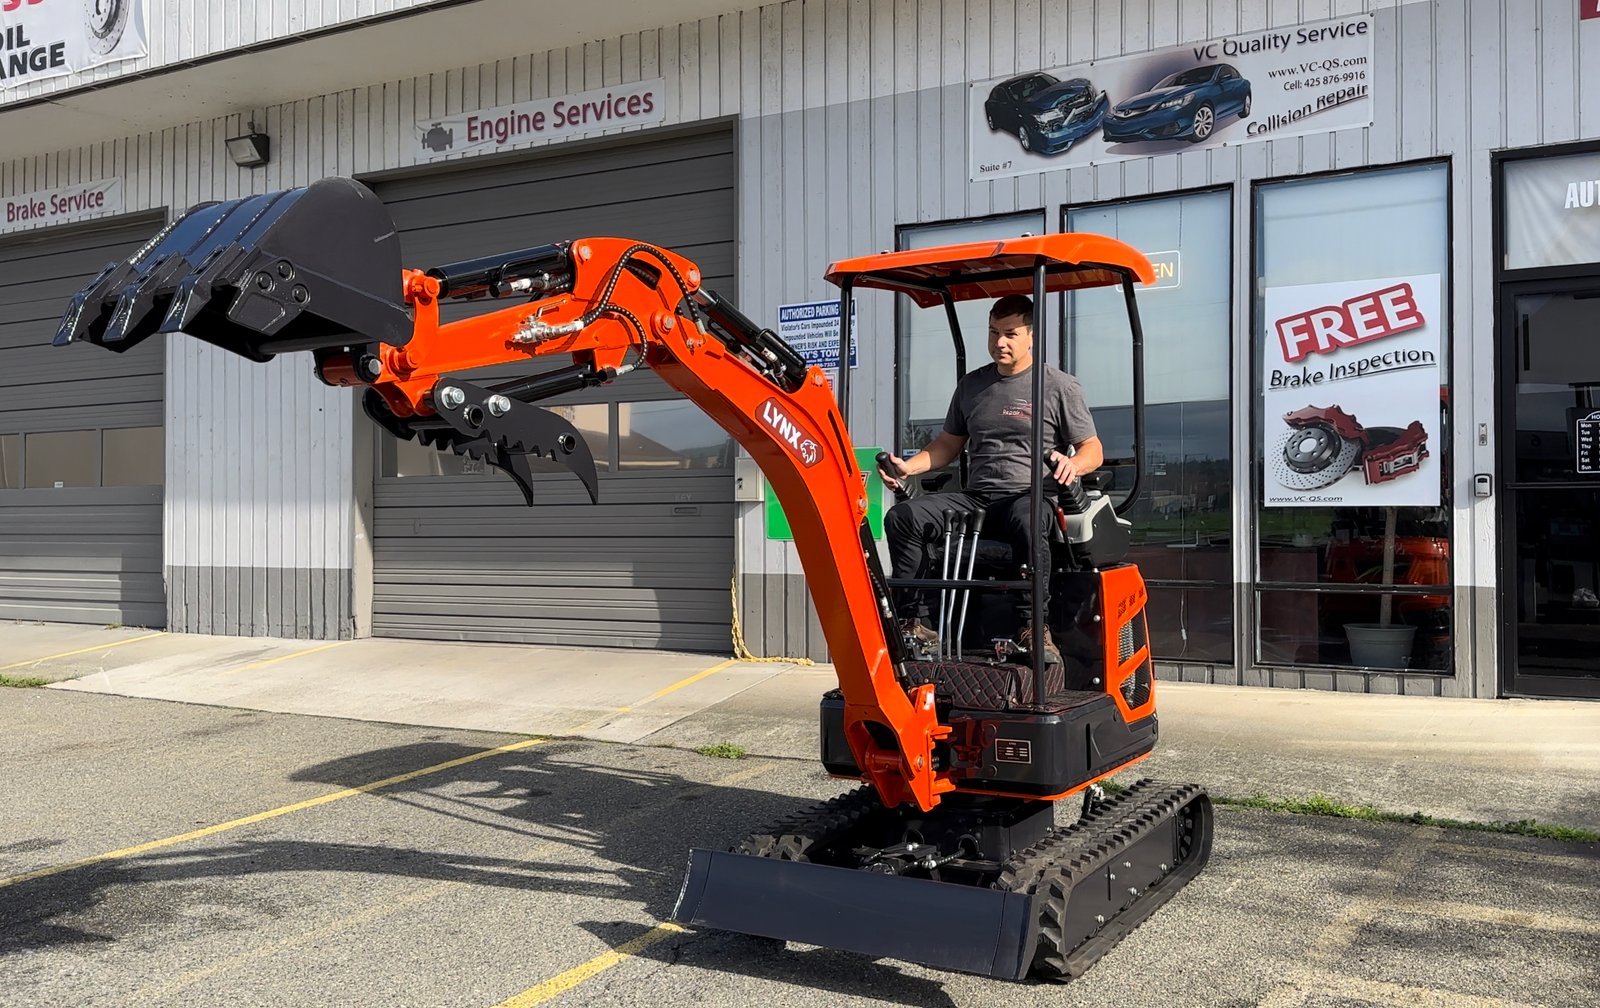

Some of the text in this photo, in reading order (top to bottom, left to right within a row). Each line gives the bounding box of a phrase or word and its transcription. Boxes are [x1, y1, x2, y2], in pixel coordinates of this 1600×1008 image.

[0, 24, 30, 51] IL
[1193, 20, 1368, 61] VC Quality Service
[1268, 56, 1367, 79] www.VC-QS.com
[1283, 71, 1366, 91] Cell: 425 876-9916
[467, 91, 654, 144] Engine Services
[1246, 84, 1368, 137] Collision Repair
[979, 160, 1012, 173] Suite #7
[6, 189, 104, 223] Brake Service
[1152, 262, 1173, 278] EN
[781, 306, 815, 321] AUTHORIZED
[815, 303, 839, 317] PARKING
[1280, 287, 1418, 359] FREE
[1270, 349, 1435, 387] Brake Inspection
[763, 401, 801, 450] LYNX
